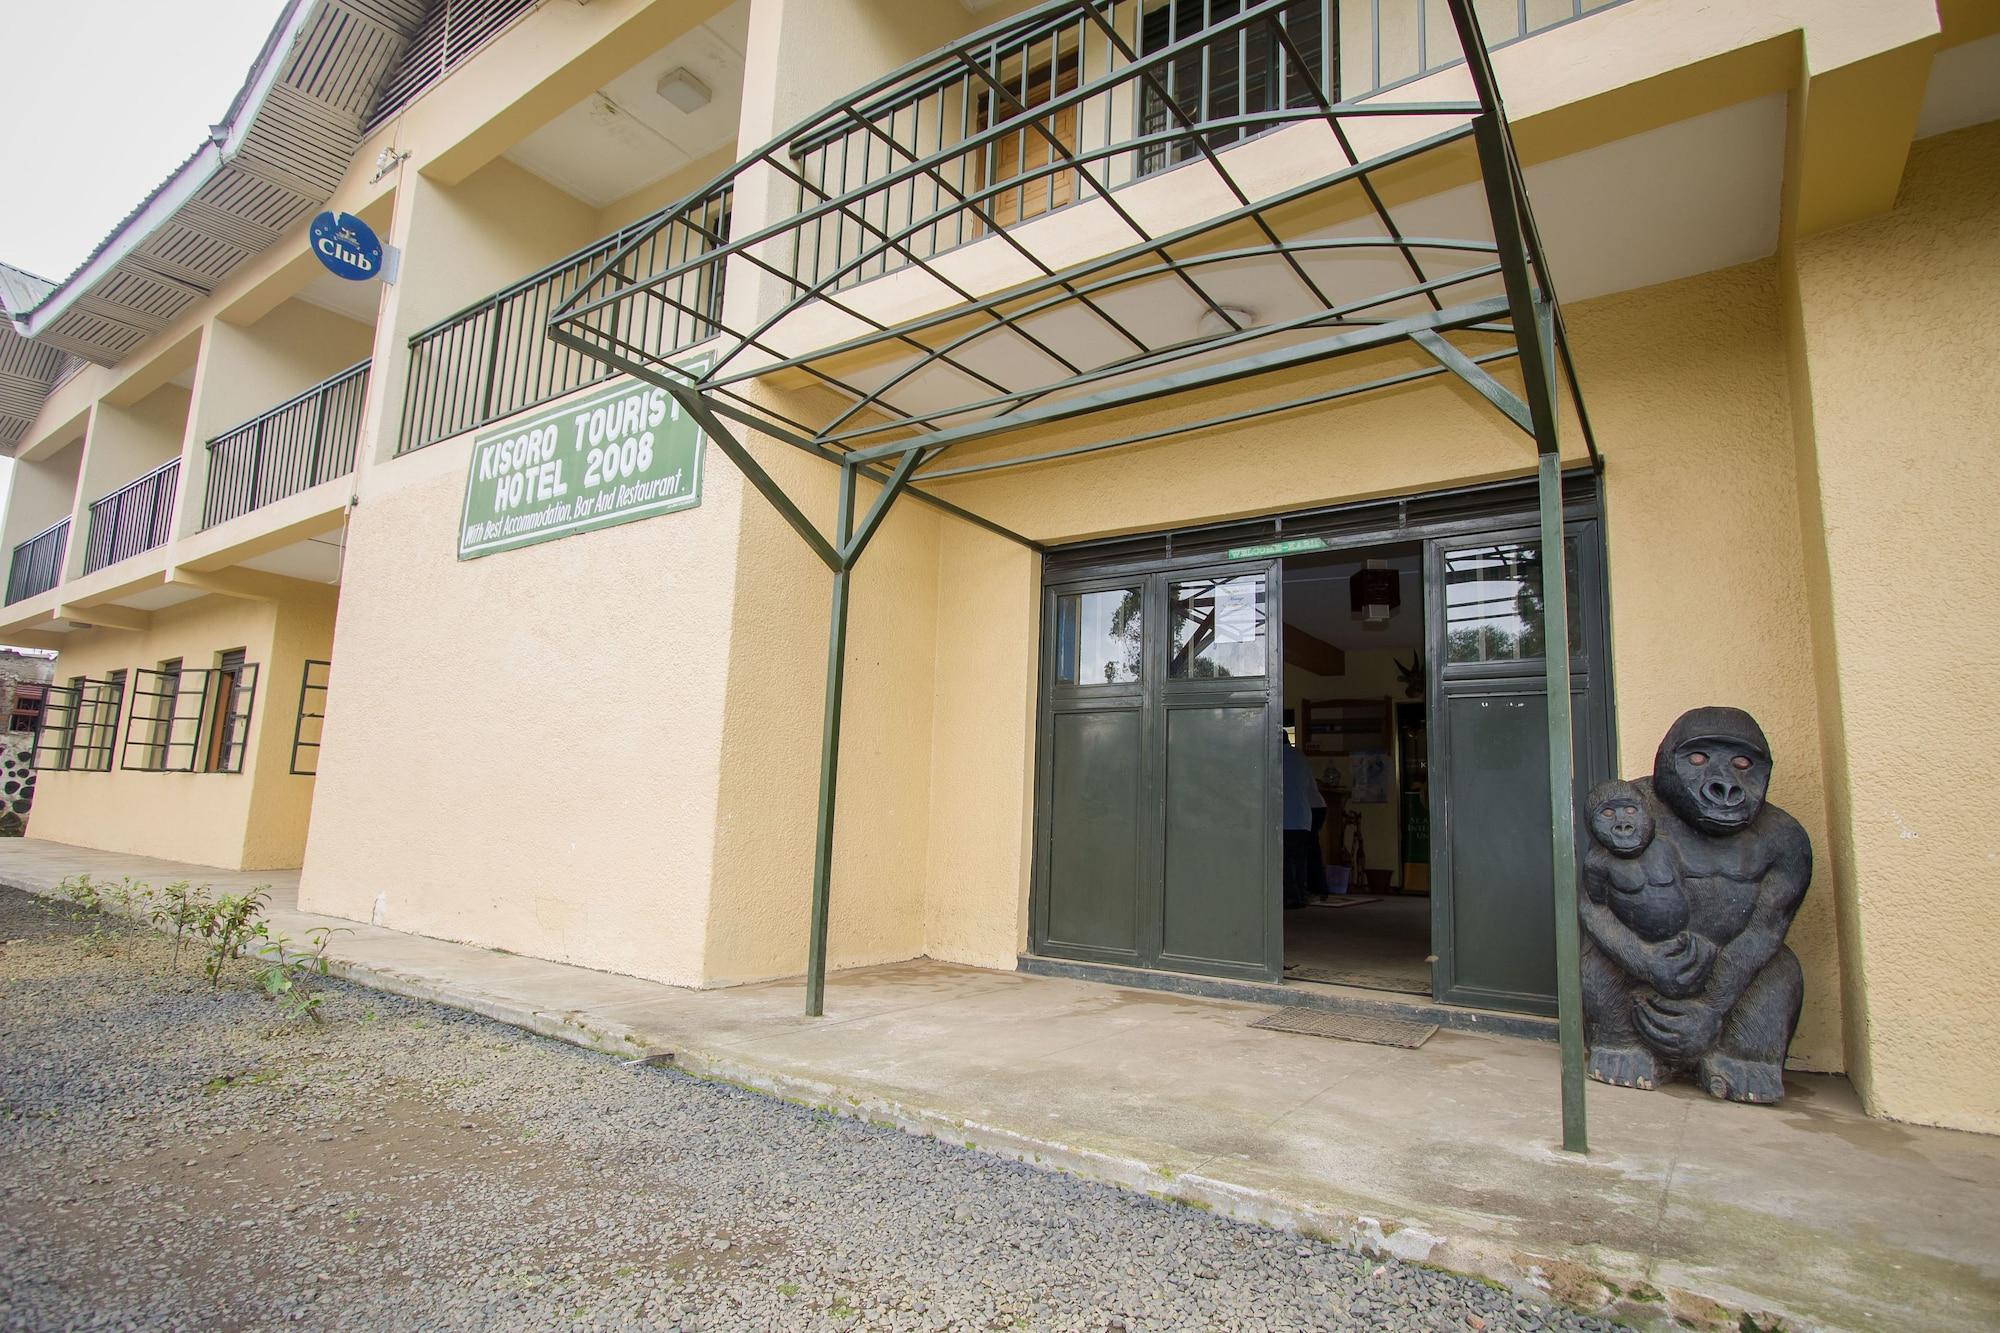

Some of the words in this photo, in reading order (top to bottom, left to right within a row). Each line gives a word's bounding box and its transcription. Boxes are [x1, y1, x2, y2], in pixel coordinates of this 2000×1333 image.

[318, 237, 372, 271] Club
[479, 424, 558, 482] KISORO
[494, 459, 568, 513] HOTEL
[583, 431, 655, 489] 2008
[465, 522, 484, 546] With
[484, 518, 504, 541] Best
[573, 494, 594, 518] Bar
[595, 489, 616, 515] And
